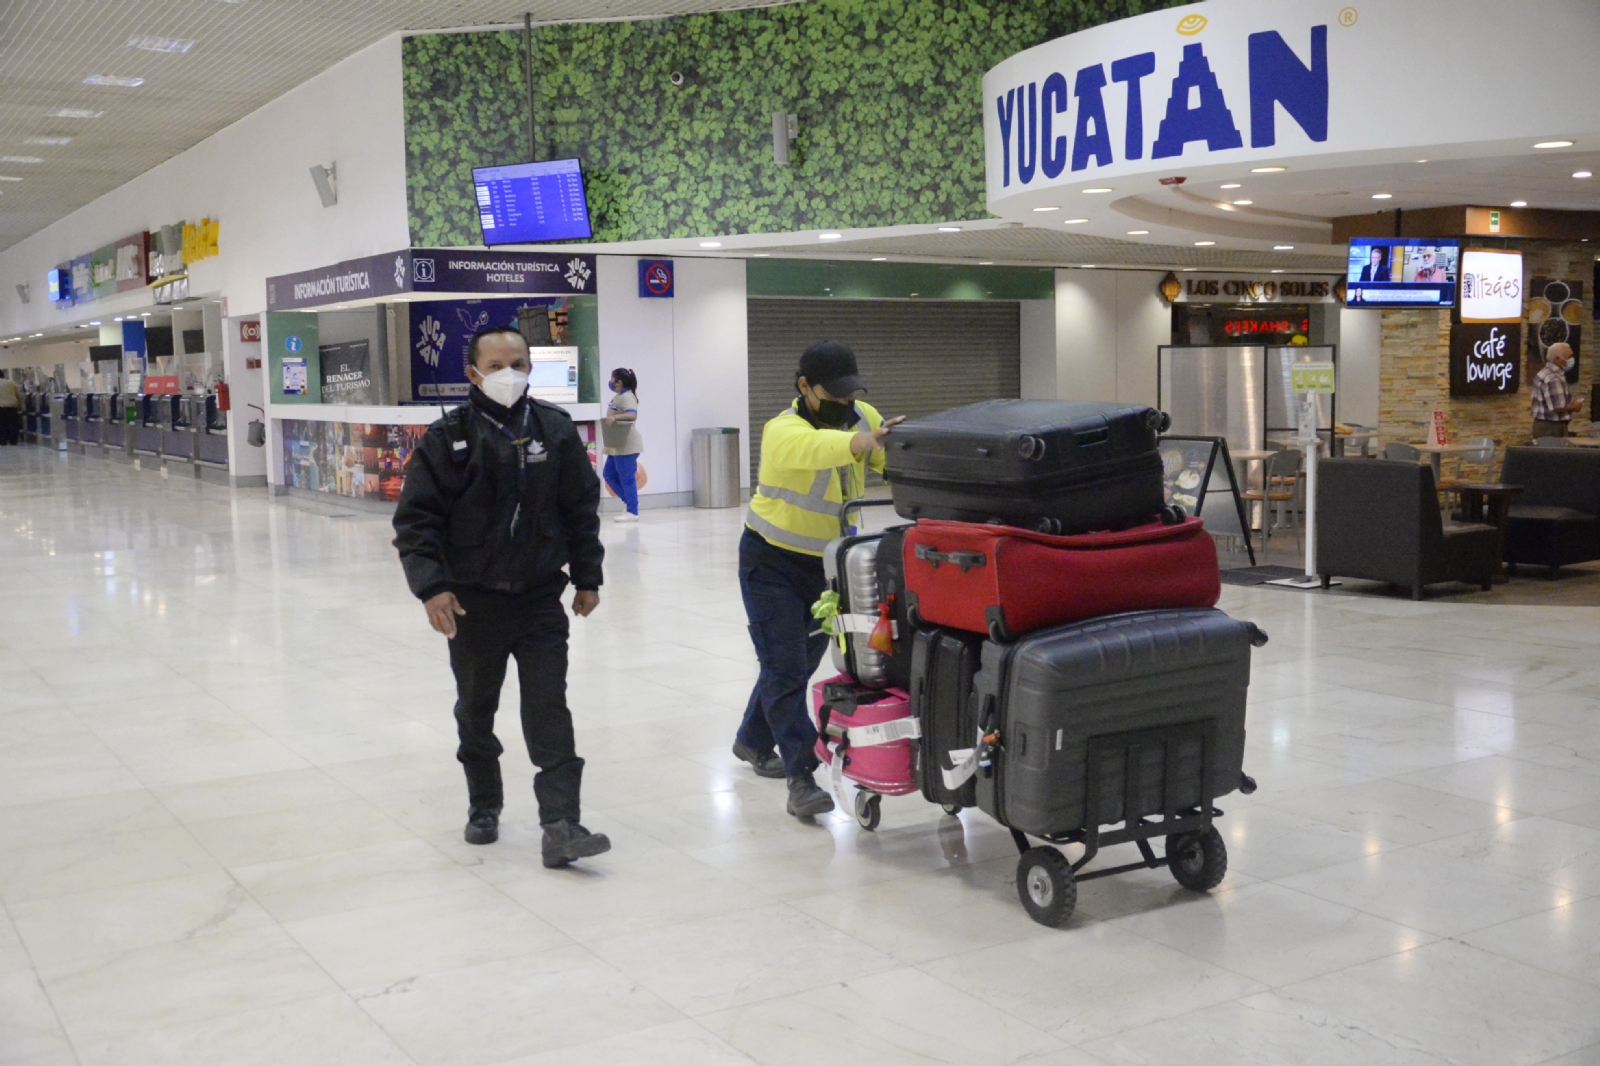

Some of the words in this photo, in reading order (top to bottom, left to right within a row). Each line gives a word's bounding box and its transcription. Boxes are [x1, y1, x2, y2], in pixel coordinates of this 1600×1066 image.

[448, 260, 515, 271] INFORMACIÓN
[516, 261, 560, 272] TURÍSTICA
[294, 275, 335, 300] INFORMACIÓN
[336, 271, 370, 293] TURÍSTICA
[486, 273, 525, 283] HOTELES
[1187, 279, 1219, 296] LOS
[1223, 280, 1278, 299] CINCO
[1280, 281, 1329, 297] SOLES
[1473, 327, 1507, 359] café
[340, 363, 351, 372] EL
[1466, 355, 1514, 390] lounge
[326, 371, 363, 383] RENACER
[321, 383, 334, 394] DEL
[335, 378, 371, 392] TURISMO
